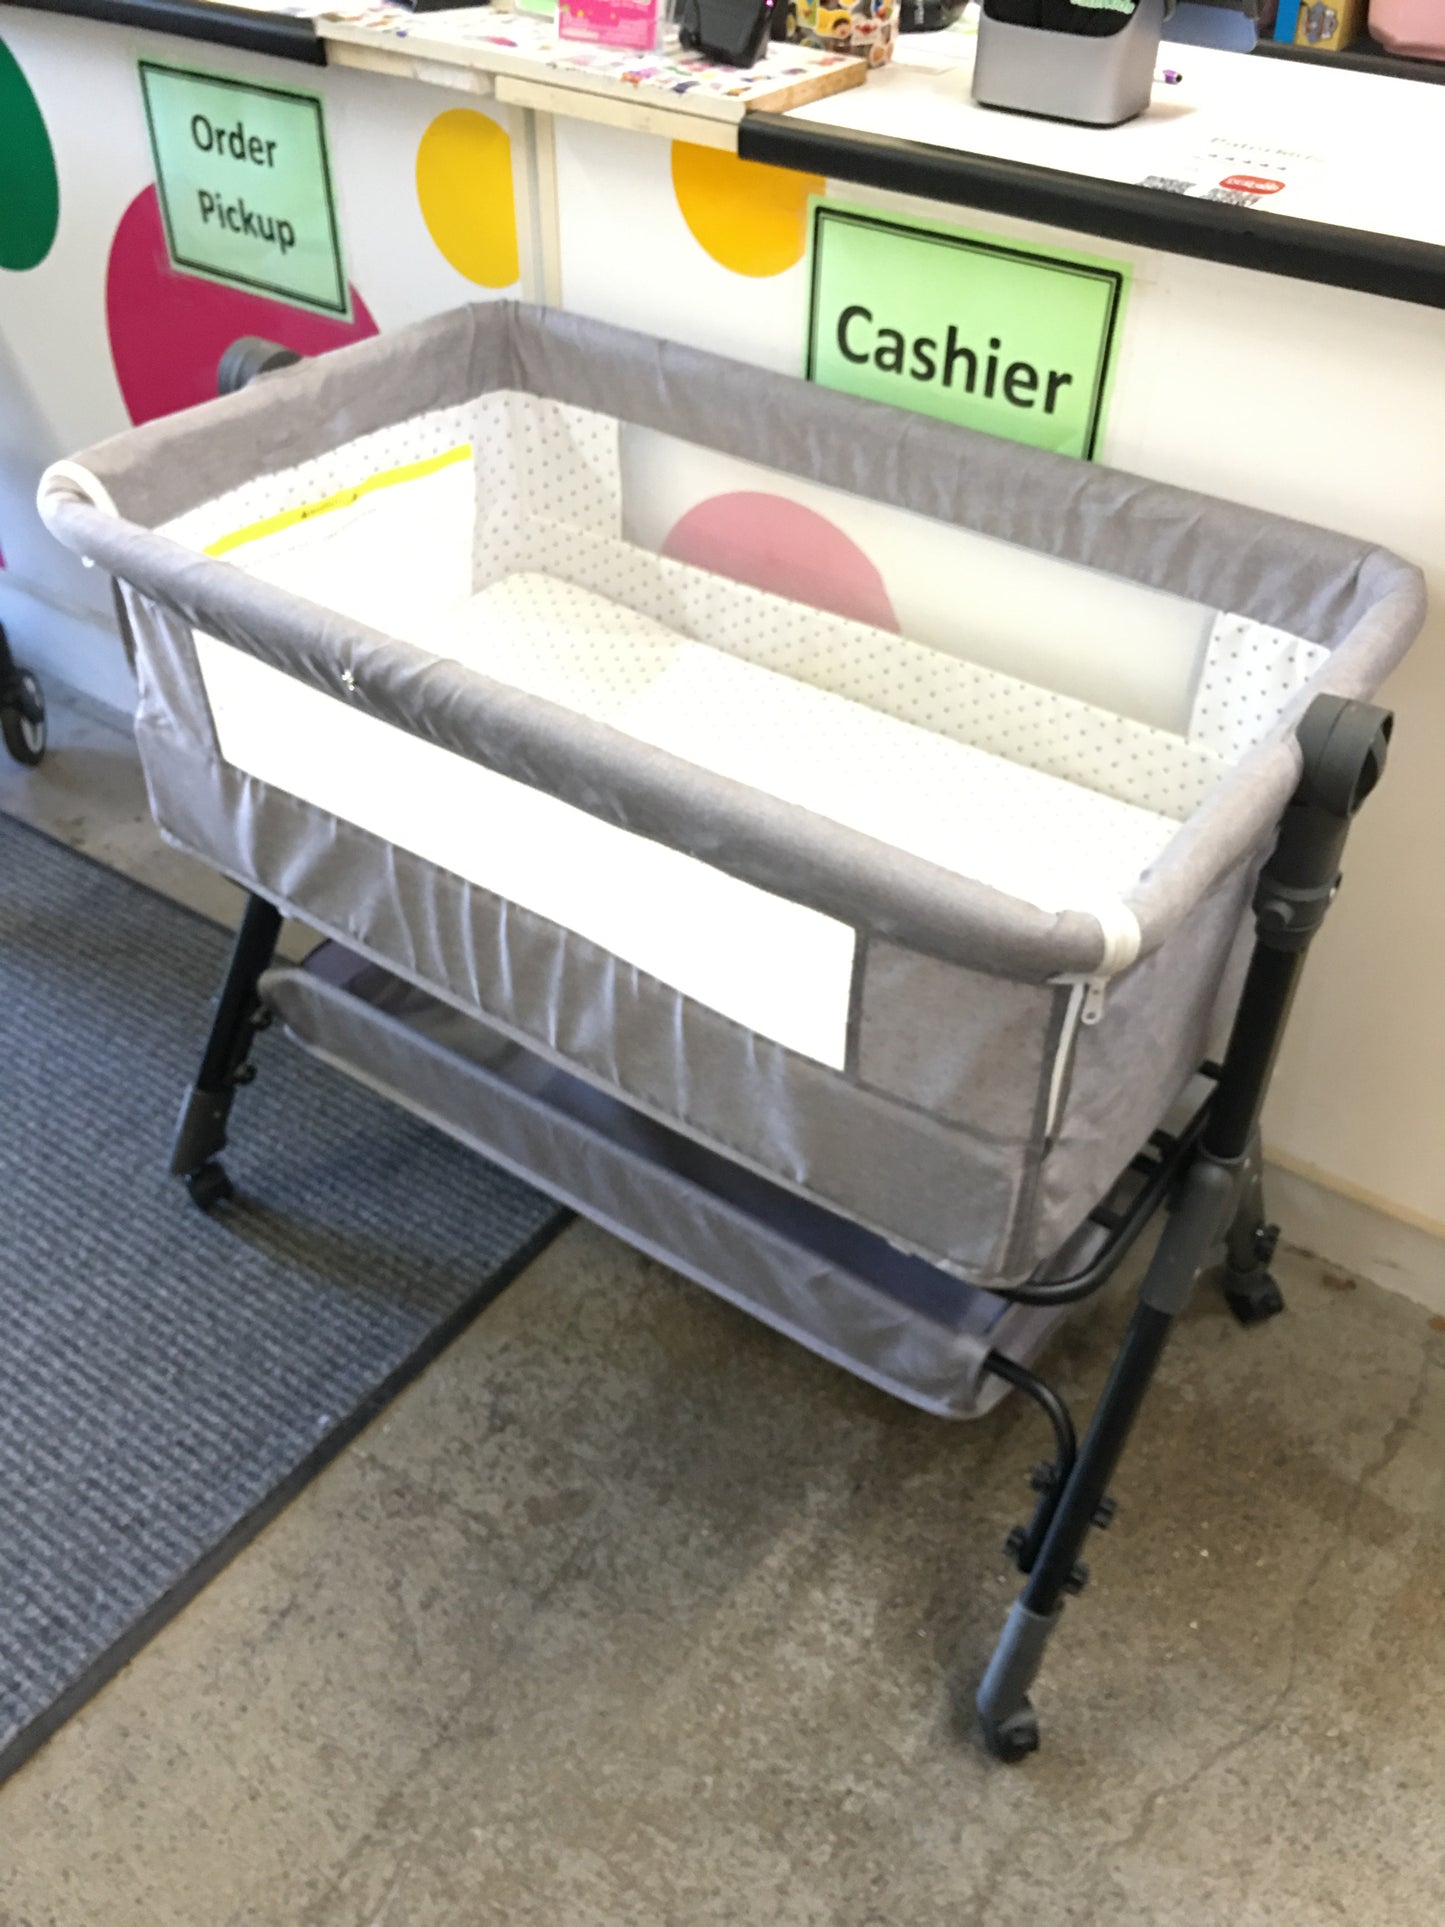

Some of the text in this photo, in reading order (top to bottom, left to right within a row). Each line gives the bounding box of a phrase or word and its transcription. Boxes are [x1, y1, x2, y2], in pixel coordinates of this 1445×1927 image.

[191, 114, 277, 167] Order
[198, 190, 296, 255] Pickup
[837, 305, 1073, 414] Cashier
